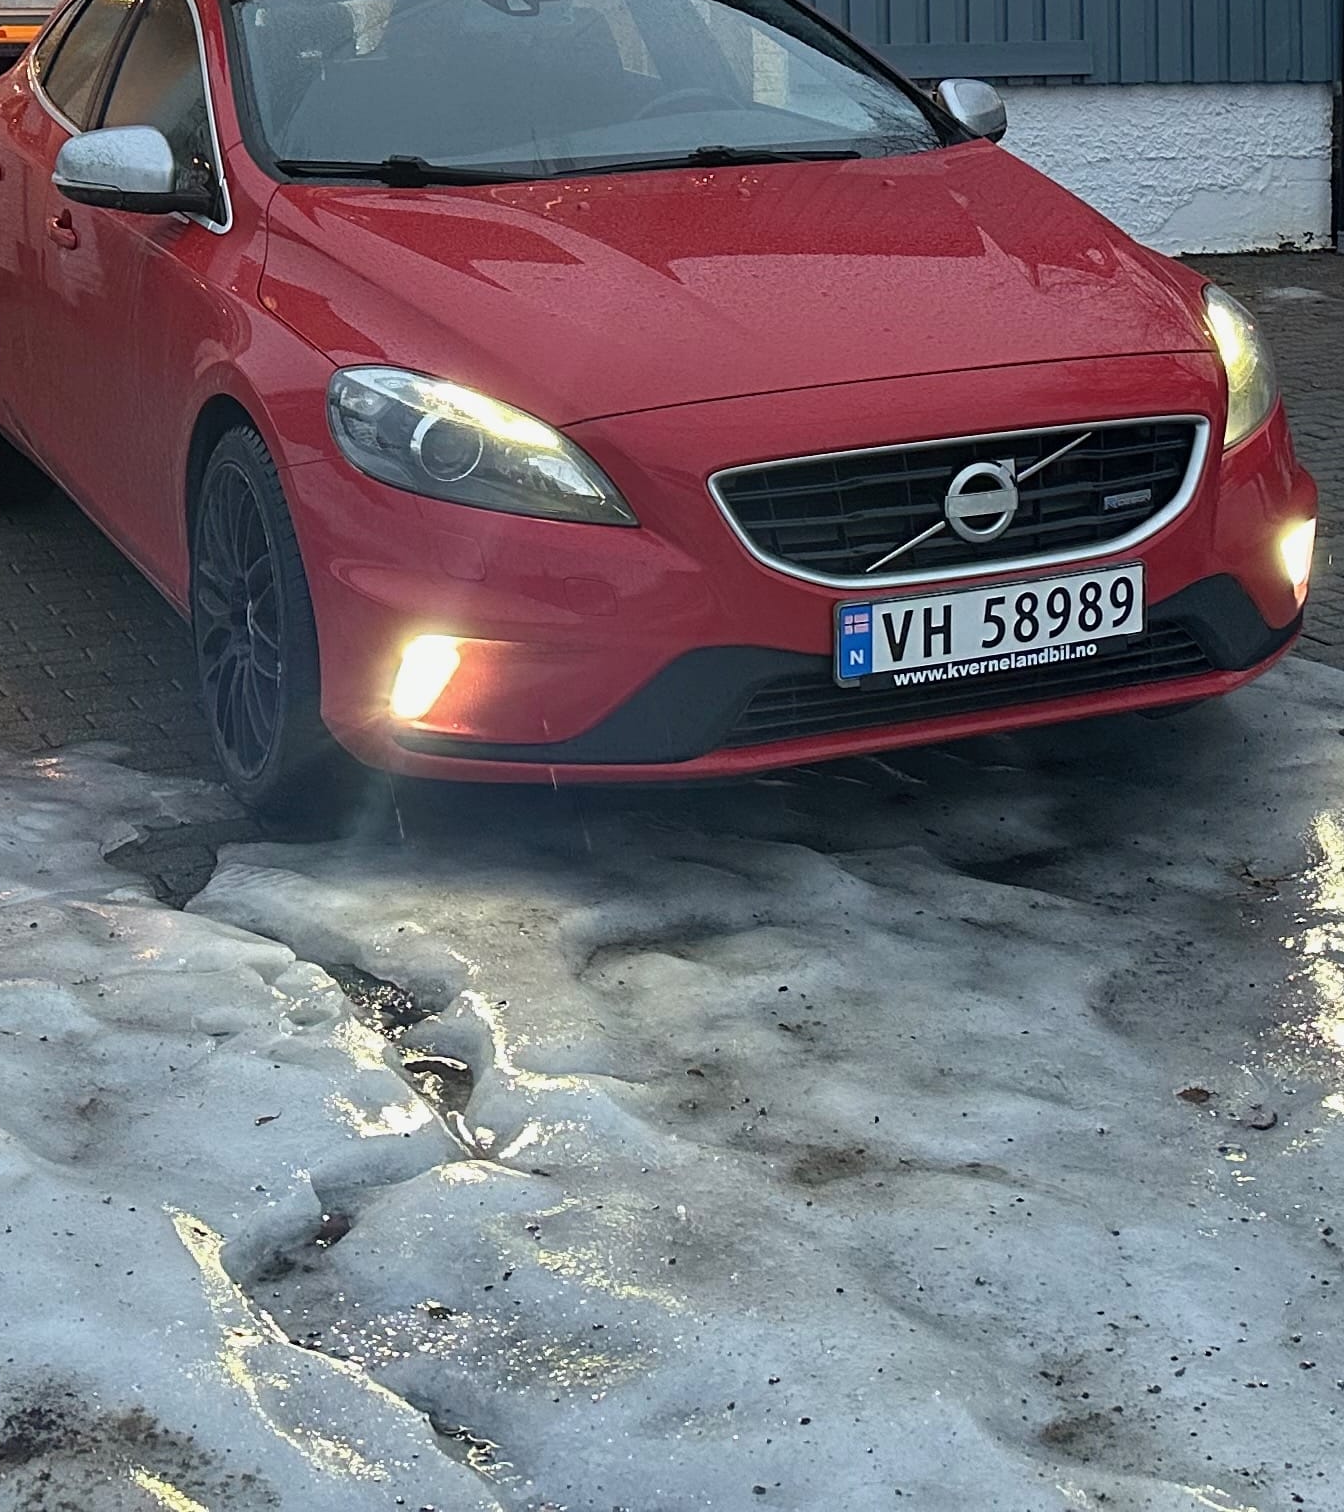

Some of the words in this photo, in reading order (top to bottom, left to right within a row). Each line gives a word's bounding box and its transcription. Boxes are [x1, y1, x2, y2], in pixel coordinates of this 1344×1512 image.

[882, 604, 952, 662] VH
[981, 576, 1134, 649] 58989
[849, 649, 864, 665] N
[893, 642, 1098, 686] www.kvernelandbil.no
